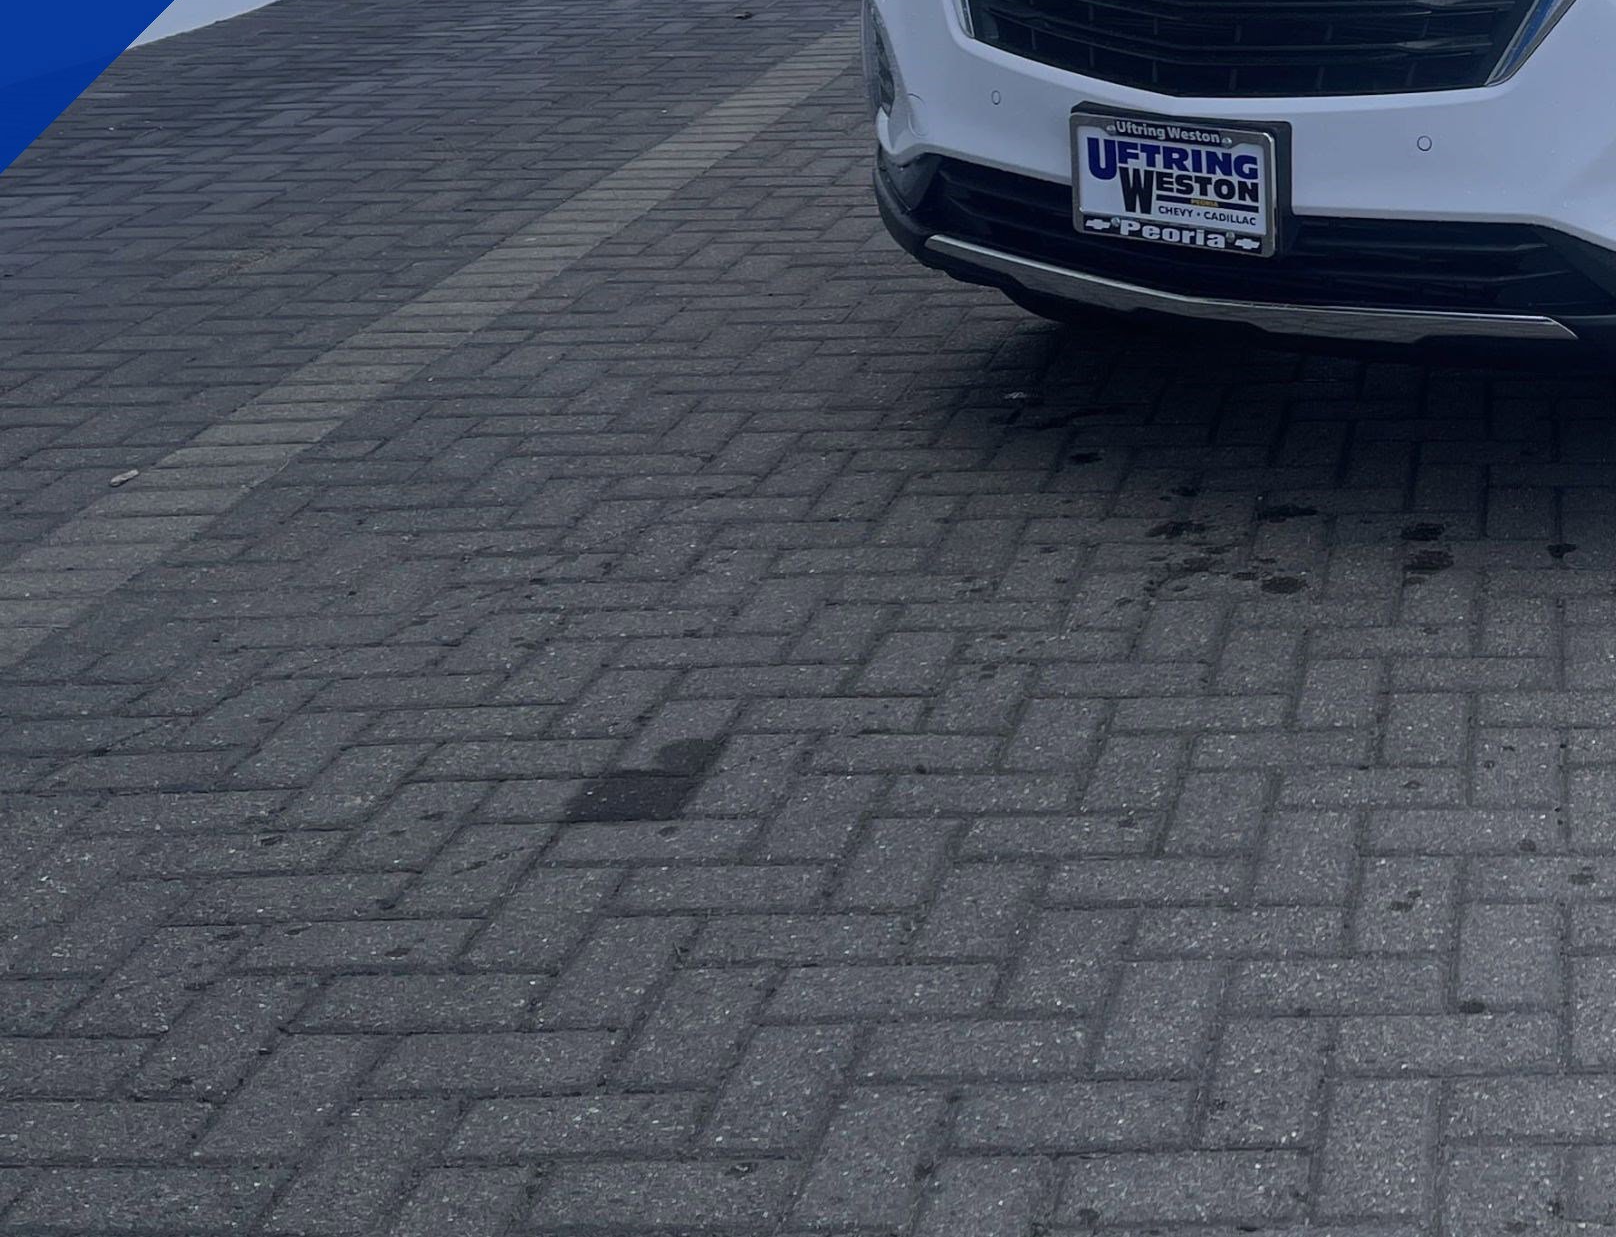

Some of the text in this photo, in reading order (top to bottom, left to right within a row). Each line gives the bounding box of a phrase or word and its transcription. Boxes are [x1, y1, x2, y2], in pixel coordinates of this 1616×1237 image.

[1115, 120, 1221, 144] Uftring Weston
[1087, 137, 1259, 181] UFTRING
[1119, 166, 1260, 214] WESTON
[1158, 205, 1257, 226] CHEVY CADILLAC
[1119, 219, 1226, 249] Peoria
